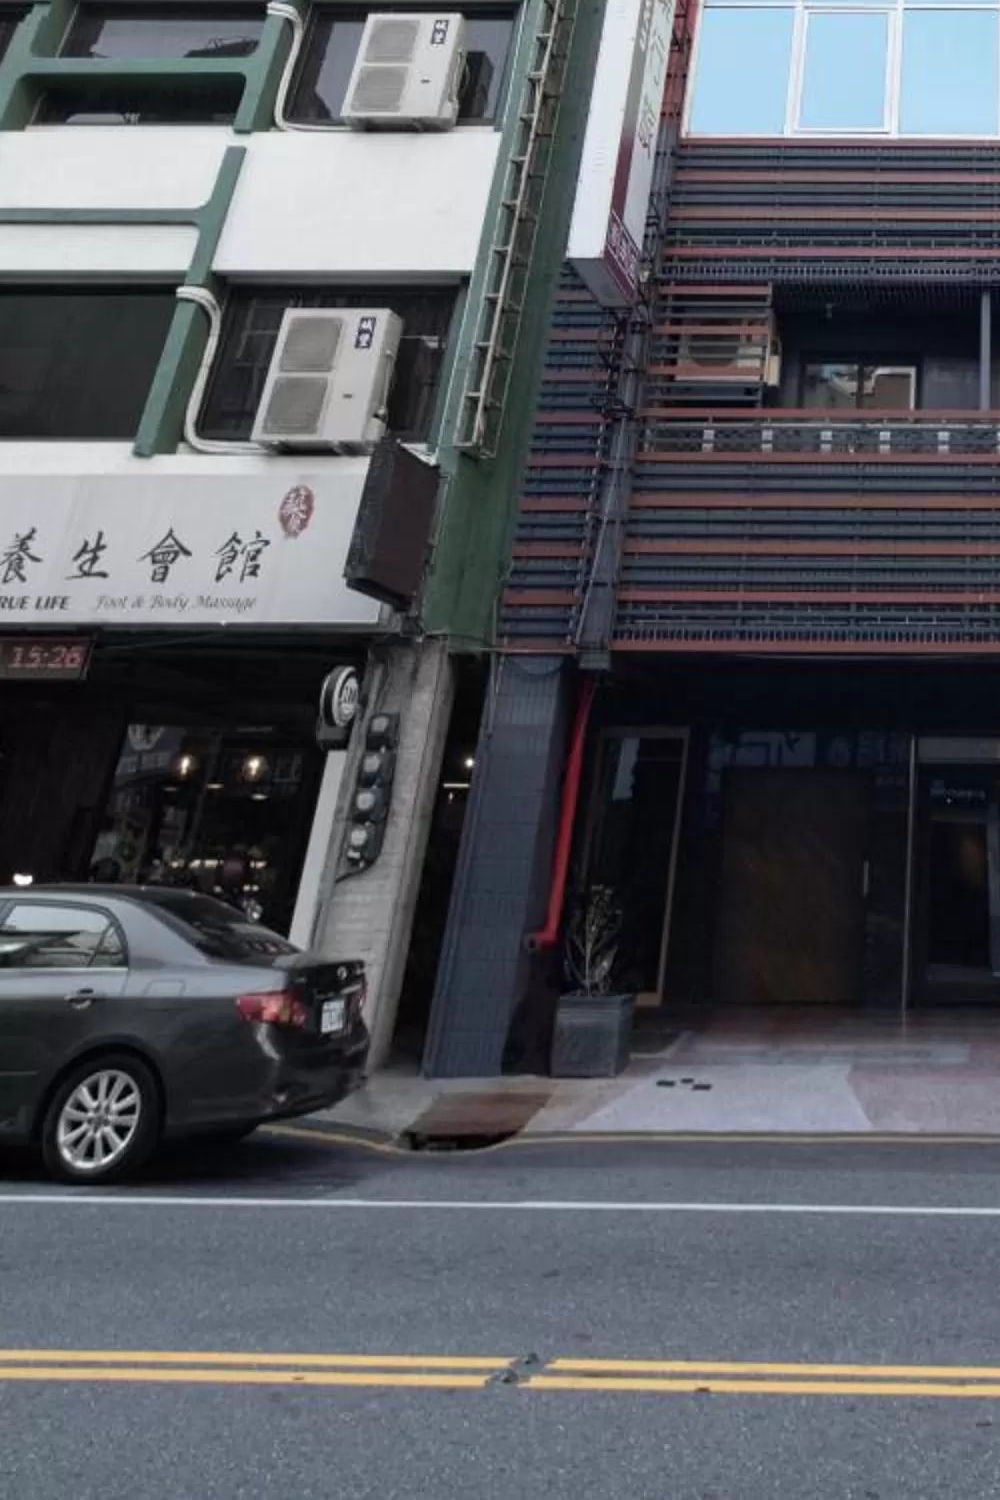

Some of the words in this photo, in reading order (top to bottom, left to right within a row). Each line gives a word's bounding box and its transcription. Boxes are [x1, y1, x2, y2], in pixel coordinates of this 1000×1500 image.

[0, 526, 271, 584] 養生會館
[35, 595, 71, 610] LIFE
[197, 595, 257, 613] Massage
